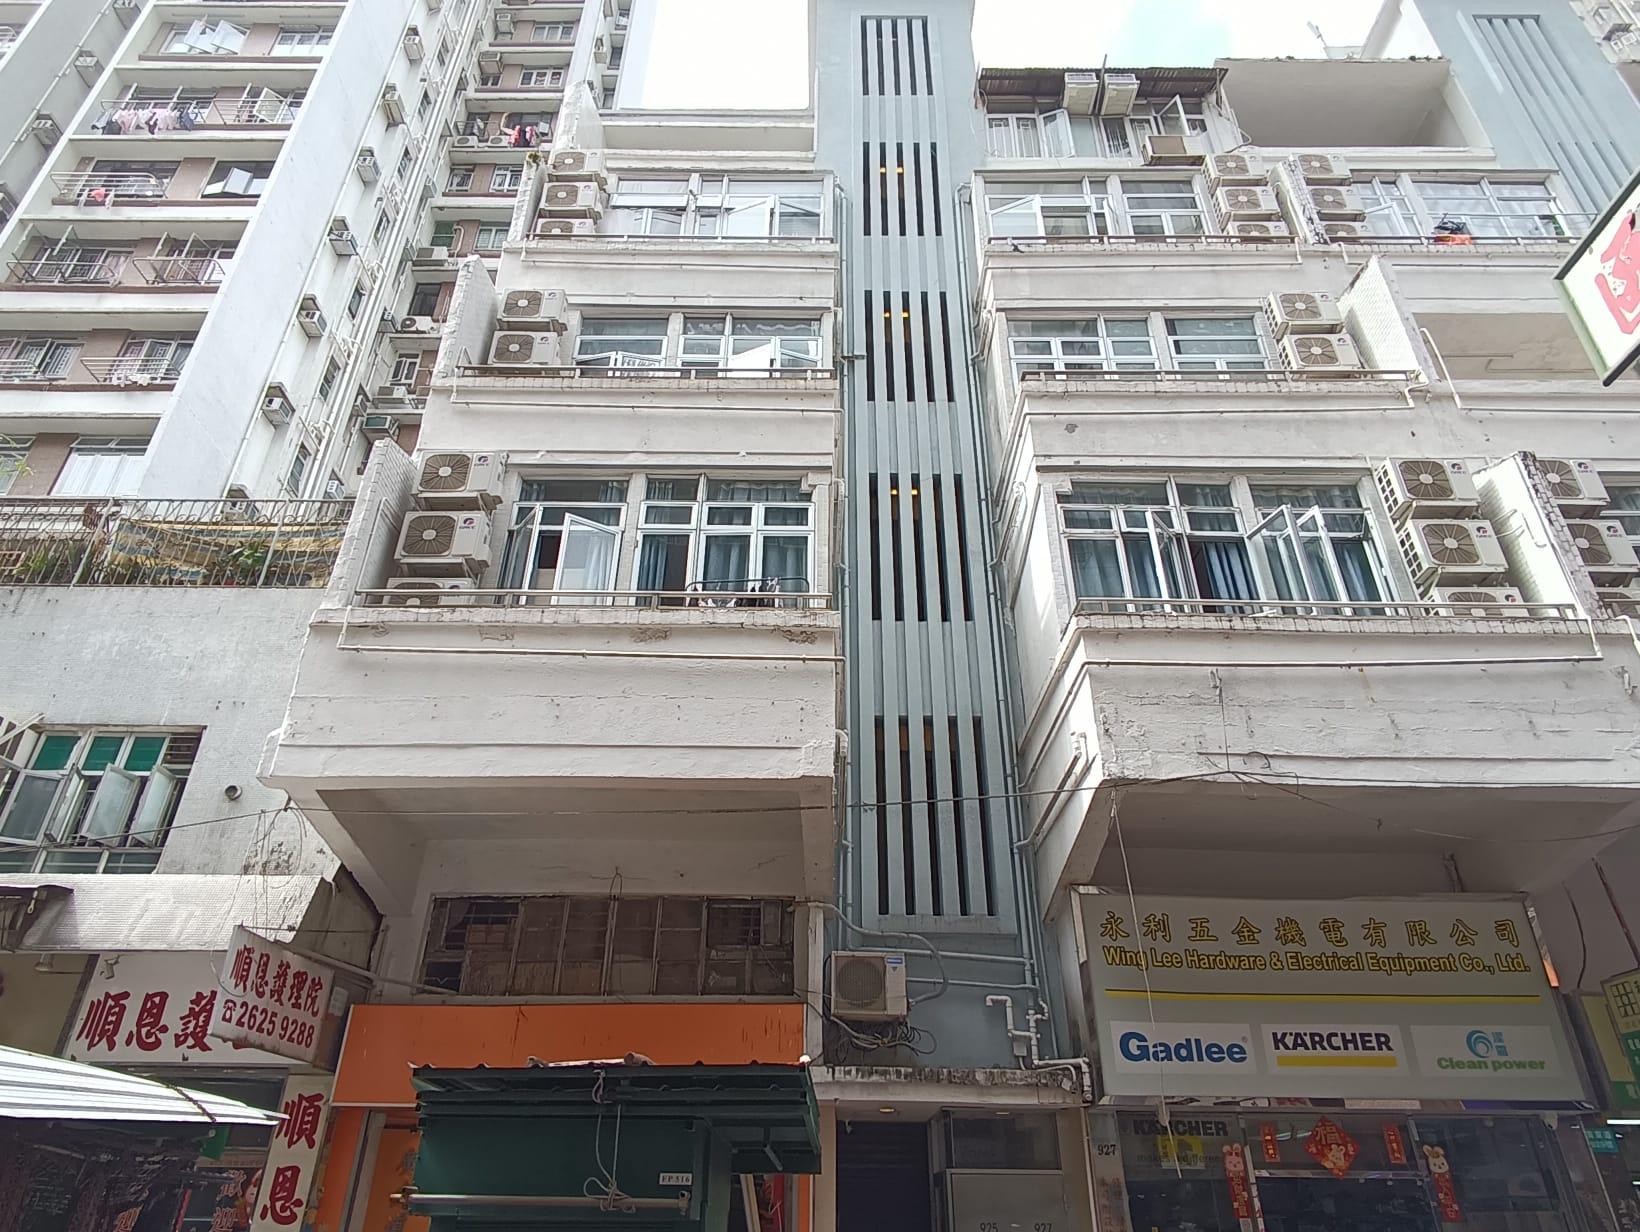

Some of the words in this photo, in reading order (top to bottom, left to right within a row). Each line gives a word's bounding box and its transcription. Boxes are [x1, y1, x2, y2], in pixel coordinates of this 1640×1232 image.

[1101, 911, 1520, 948] 永利五金機電有限公司
[1103, 946, 1148, 971] Wing
[1151, 948, 1183, 967] Lee
[1185, 949, 1266, 970] Hardware
[1270, 952, 1284, 970] &
[1287, 951, 1364, 971] Electrical
[1366, 953, 1458, 975] Equipment
[1458, 953, 1495, 975] Co.,
[1496, 953, 1531, 973] Ltd.
[230, 944, 322, 1018] 順恩護理院
[76, 989, 254, 1052] 順恩護
[235, 1001, 278, 1037] 2625
[279, 1015, 315, 1049] 9288
[1119, 1031, 1248, 1063] Gadlee
[1437, 1057, 1488, 1070] Clean
[1492, 1059, 1545, 1073] power
[1098, 1144, 1117, 1156] 927
